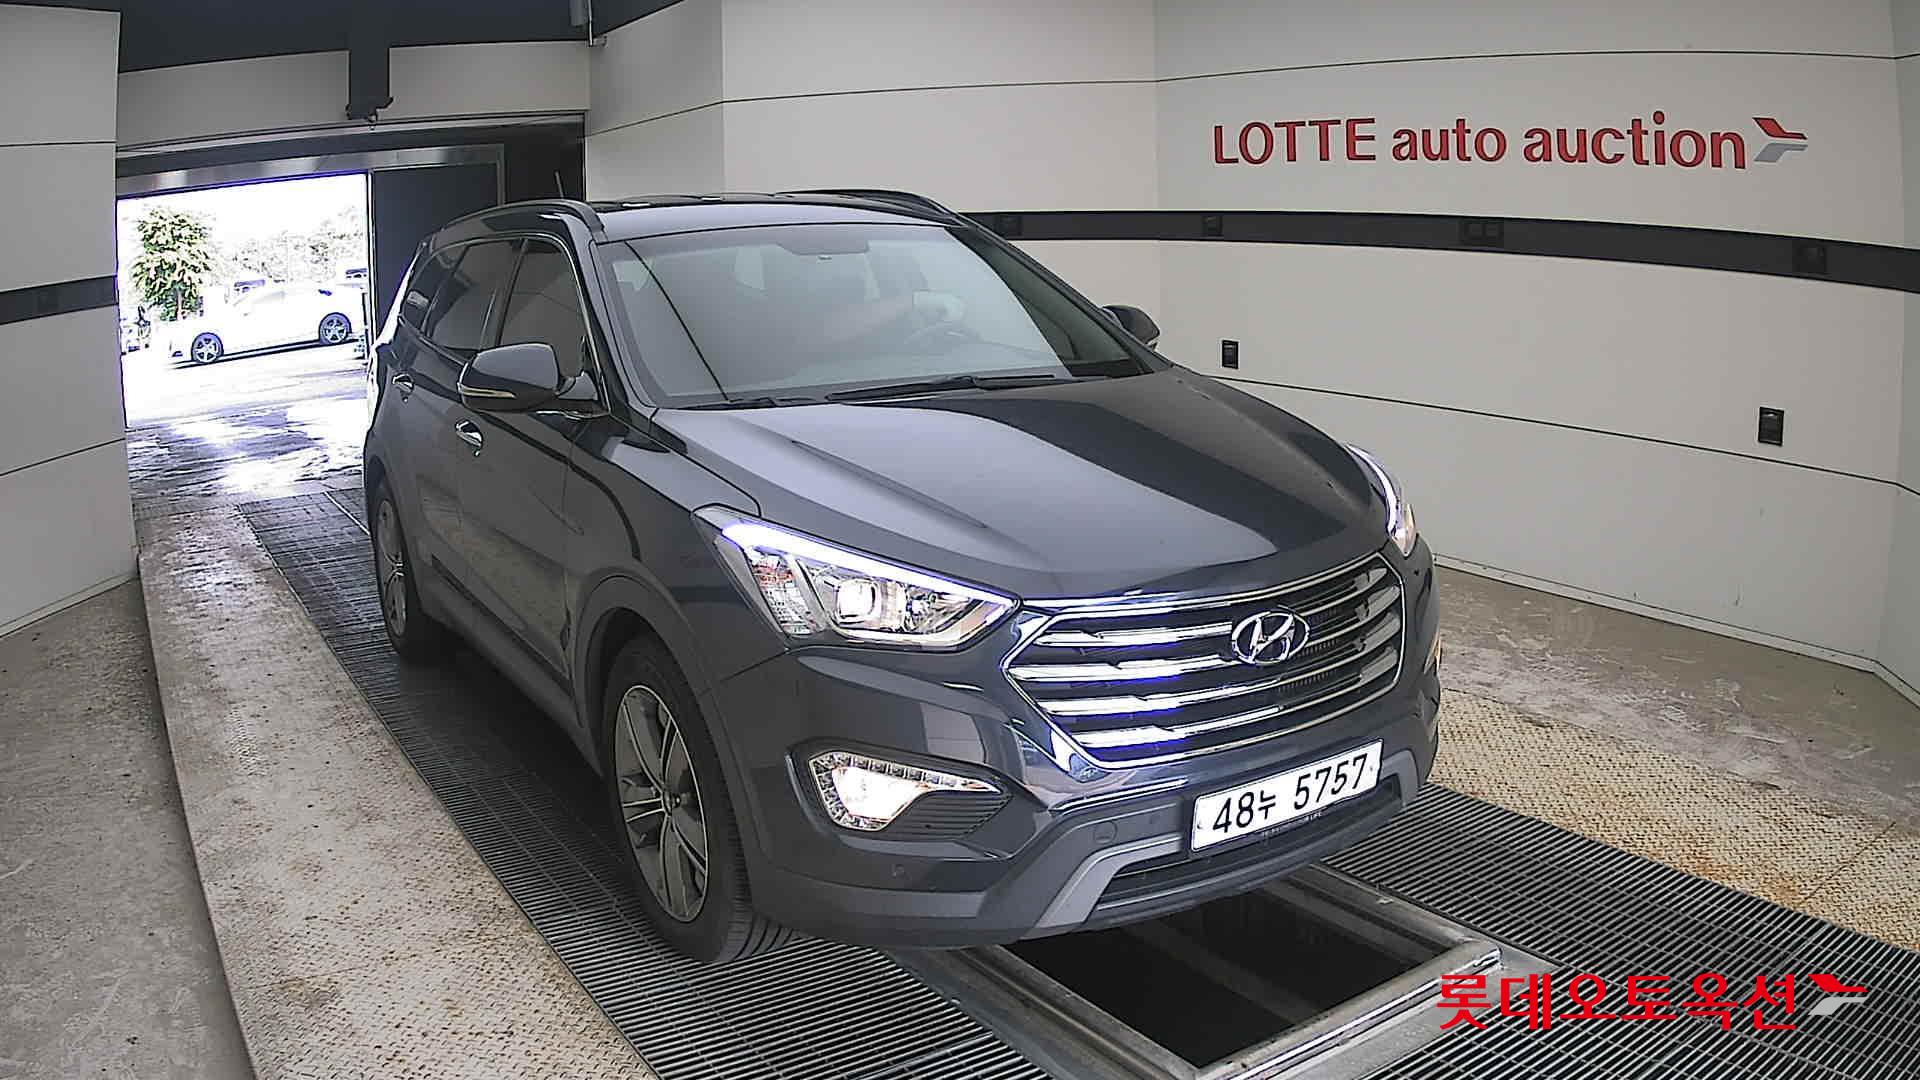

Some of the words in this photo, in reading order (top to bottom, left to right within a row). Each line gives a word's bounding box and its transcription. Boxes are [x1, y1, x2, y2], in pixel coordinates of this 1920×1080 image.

[1213, 117, 1377, 164] LOTTE
[1391, 118, 1508, 162] auto
[1522, 111, 1747, 169] auction
[1212, 789, 1277, 834] 48누
[1293, 752, 1369, 811] 5757
